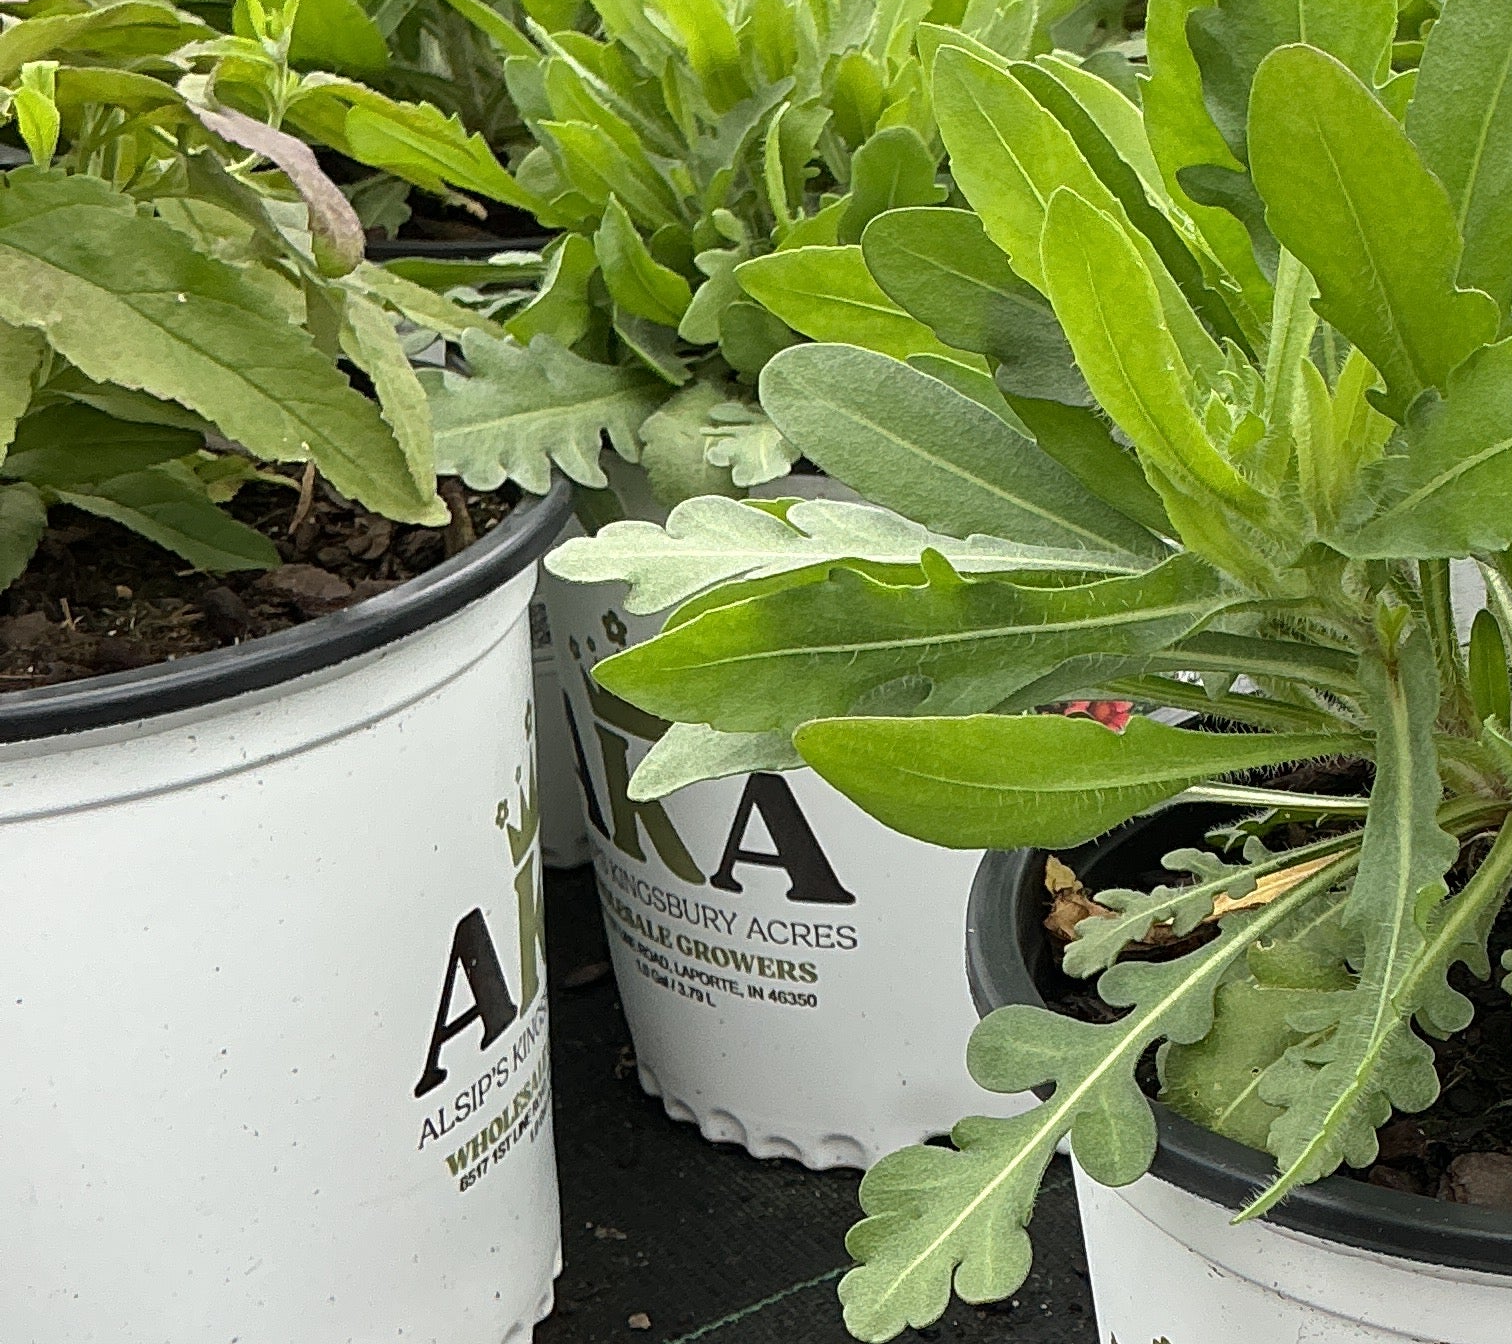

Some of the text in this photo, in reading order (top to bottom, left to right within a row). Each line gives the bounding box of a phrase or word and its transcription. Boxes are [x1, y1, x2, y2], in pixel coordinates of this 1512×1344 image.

[746, 916, 859, 950] ACRES
[675, 933, 818, 984] GROWERS
[747, 983, 765, 1001] IN
[767, 990, 818, 1008] 46350
[417, 1056, 509, 1151] ALSIP'S
